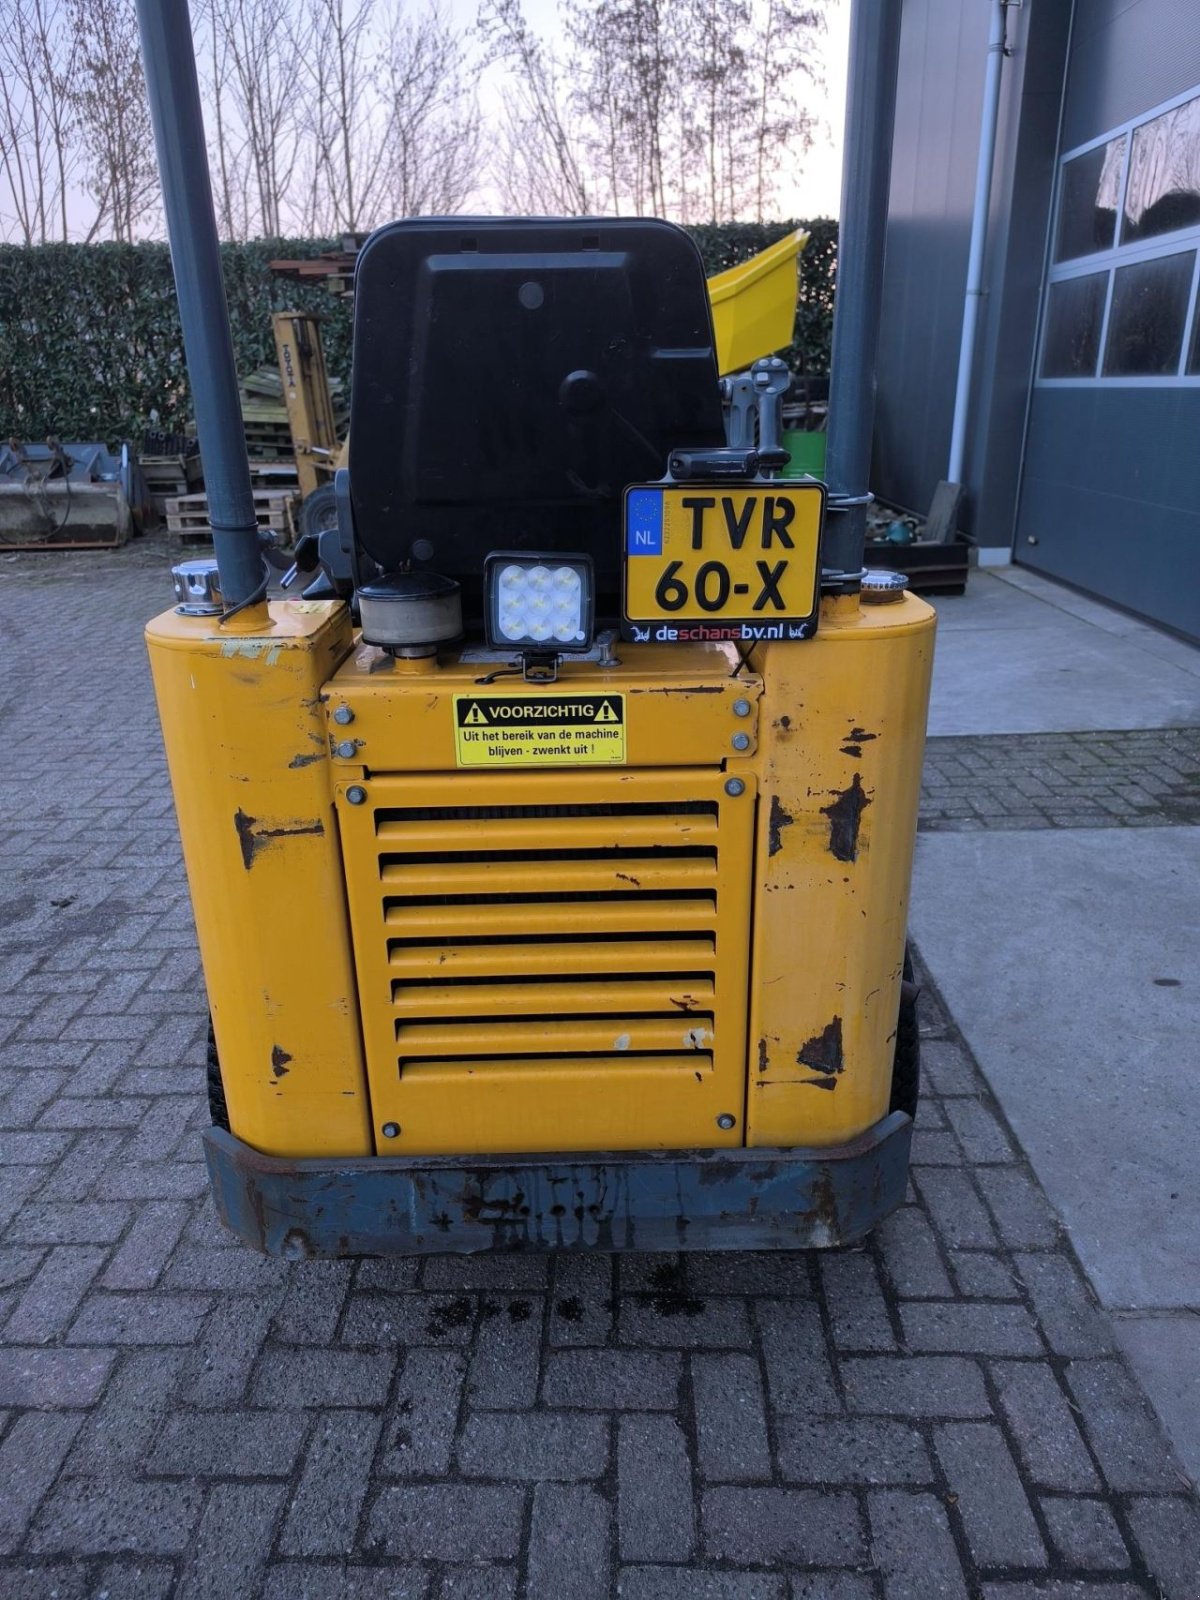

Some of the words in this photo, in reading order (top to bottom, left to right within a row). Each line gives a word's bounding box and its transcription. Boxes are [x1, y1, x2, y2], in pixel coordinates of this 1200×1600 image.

[283, 344, 296, 388] TOYOTA
[682, 497, 796, 550] TVR
[635, 531, 656, 545] NL
[655, 560, 789, 612] 60-X
[655, 623, 784, 641] deschansbv.nl
[489, 704, 595, 719] VOORZICHTIG
[463, 731, 479, 742] Uit
[482, 731, 499, 741] het
[502, 730, 534, 741] bereik
[537, 732, 556, 740] van
[559, 729, 572, 739] de
[575, 729, 619, 739] machine
[488, 746, 523, 758] blijven
[532, 745, 571, 755] zwenkt
[574, 744, 588, 754] uit
